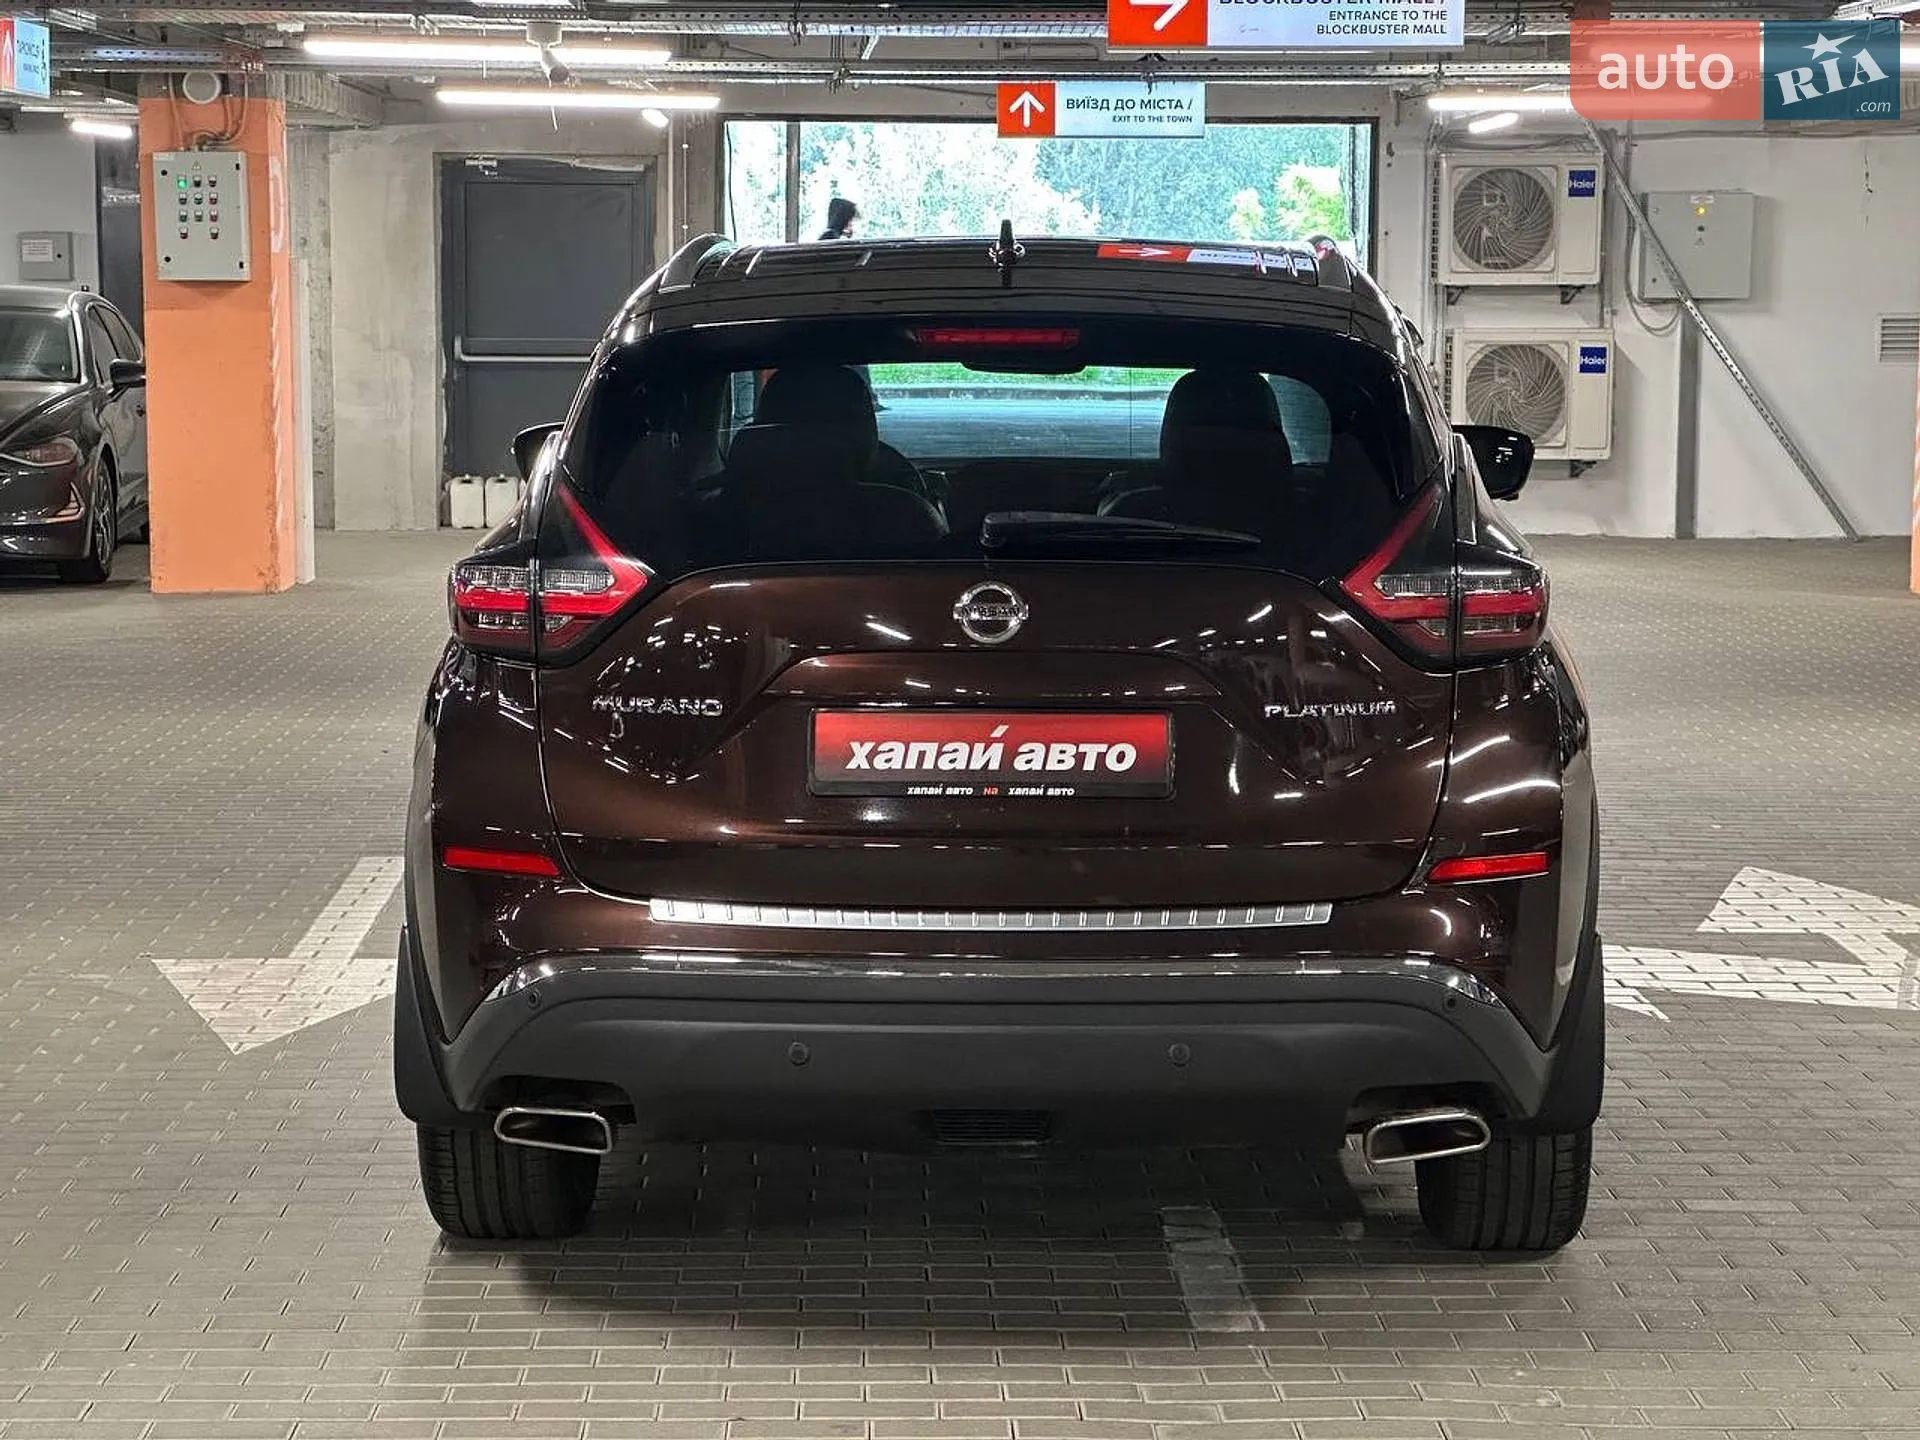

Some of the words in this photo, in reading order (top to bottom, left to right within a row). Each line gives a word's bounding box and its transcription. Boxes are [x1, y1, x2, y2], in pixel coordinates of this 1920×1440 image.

[1328, 10, 1398, 21] ENTRANCE
[1401, 10, 1419, 21] TO
[1422, 10, 1448, 21] THE
[1316, 23, 1410, 35] BLOCKBUSTER
[1412, 23, 1448, 35] MALL
[1066, 96, 1110, 111] ВИЇЗД
[1114, 98, 1136, 111] ДО
[1139, 98, 1184, 110] МІСТА
[1112, 115, 1131, 123] EXIT
[1133, 115, 1146, 123] TO
[1148, 115, 1164, 123] THE
[1166, 115, 1193, 123] TOWN
[1580, 355, 1607, 365] Haier
[592, 696, 723, 716] MURANO
[1264, 700, 1396, 718] PLATINUM
[845, 724, 1009, 771] хапай
[1013, 742, 1138, 772] авто
[945, 786, 974, 795] авто
[1046, 787, 1075, 796] авто
